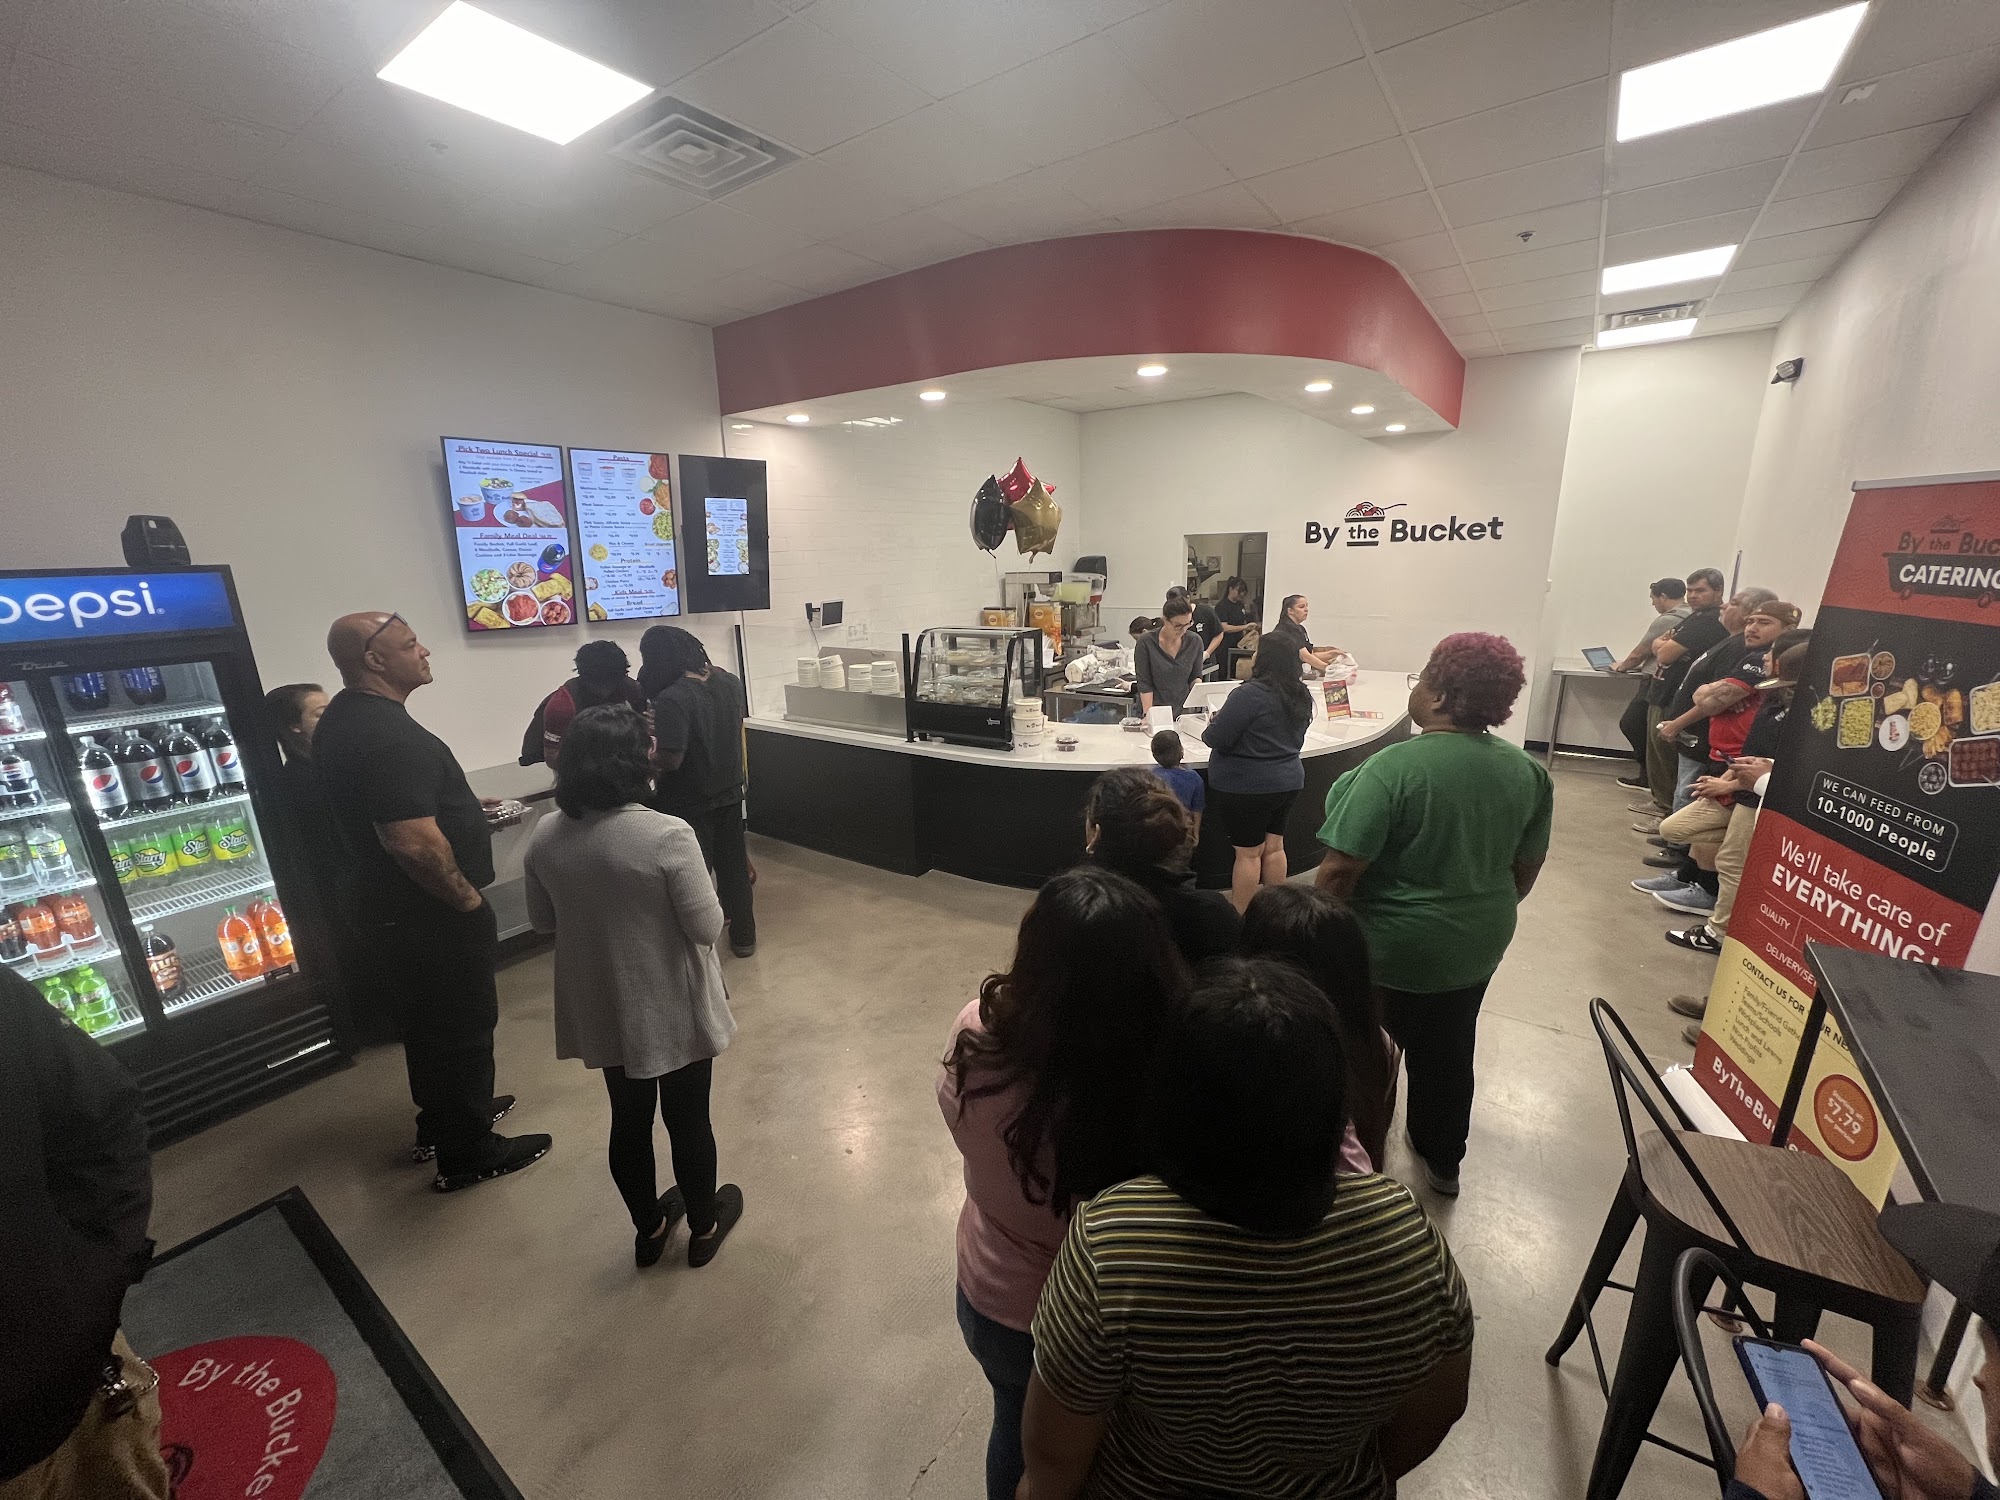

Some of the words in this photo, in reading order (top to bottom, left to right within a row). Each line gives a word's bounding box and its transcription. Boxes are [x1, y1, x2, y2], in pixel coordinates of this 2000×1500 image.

[458, 445, 473, 453] Pick
[475, 446, 490, 454] Two
[492, 447, 513, 455] Lunch
[514, 449, 538, 457] Special
[1305, 521, 1340, 550] By
[1348, 524, 1379, 540] the
[1390, 515, 1504, 543] Bucket
[1898, 531, 1925, 555] By
[1929, 538, 1951, 551] the
[1822, 778, 1838, 793] WE
[1842, 786, 1867, 805] CAN
[1869, 797, 1901, 819] FEED
[1905, 812, 1945, 837] FROM
[1817, 796, 1874, 833] 10-1000
[1878, 823, 1936, 861] People
[134, 851, 166, 867] Starry
[1781, 836, 1821, 876] We'll
[1824, 864, 1863, 900] take
[1866, 893, 1912, 929] care
[1917, 922, 1951, 947] of
[1760, 903, 1791, 930] QUALITY
[1742, 958, 1775, 989] CONTACT
[1775, 985, 1788, 1000] US
[1788, 996, 1806, 1016] FOR
[1743, 985, 1783, 1024] Family/Friend
[1735, 1015, 1750, 1034] Lunch
[1750, 1031, 1763, 1046] and
[1738, 1005, 1767, 1037] Workplace
[1741, 996, 1782, 1037] Teams/Schools
[1729, 1033, 1756, 1066] Weddings
[1732, 1024, 1763, 1059] Non-Profits
[1827, 1097, 1862, 1135] $7.79
[178, 1357, 234, 1392] By
[231, 1359, 281, 1397] the
